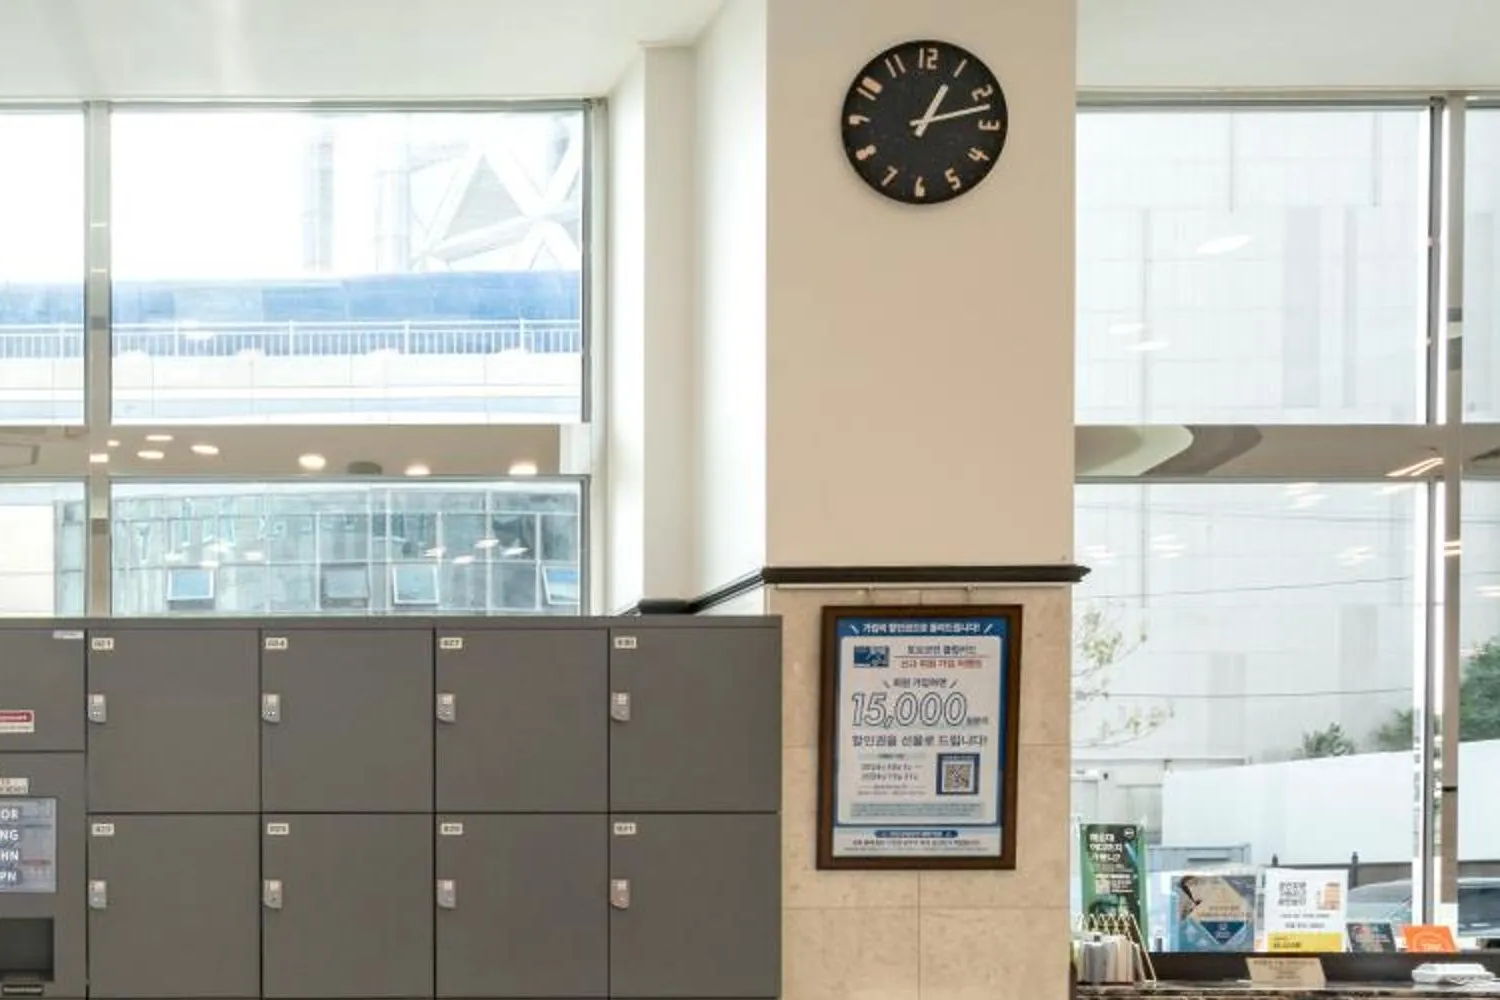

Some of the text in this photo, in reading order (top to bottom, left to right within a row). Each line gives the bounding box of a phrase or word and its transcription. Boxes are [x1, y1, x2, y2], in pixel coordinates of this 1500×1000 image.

[884, 53, 907, 79] 11
[918, 47, 939, 70] 12
[954, 58, 968, 78] 1
[855, 76, 884, 101] 10
[971, 84, 994, 101] 2
[848, 113, 871, 126] 9
[977, 119, 1001, 132] 3
[855, 144, 877, 161] 8
[967, 146, 990, 163] 4
[881, 165, 898, 187] 7
[914, 176, 926, 198] 6
[944, 167, 962, 191] 5
[851, 691, 968, 729] 15,000
